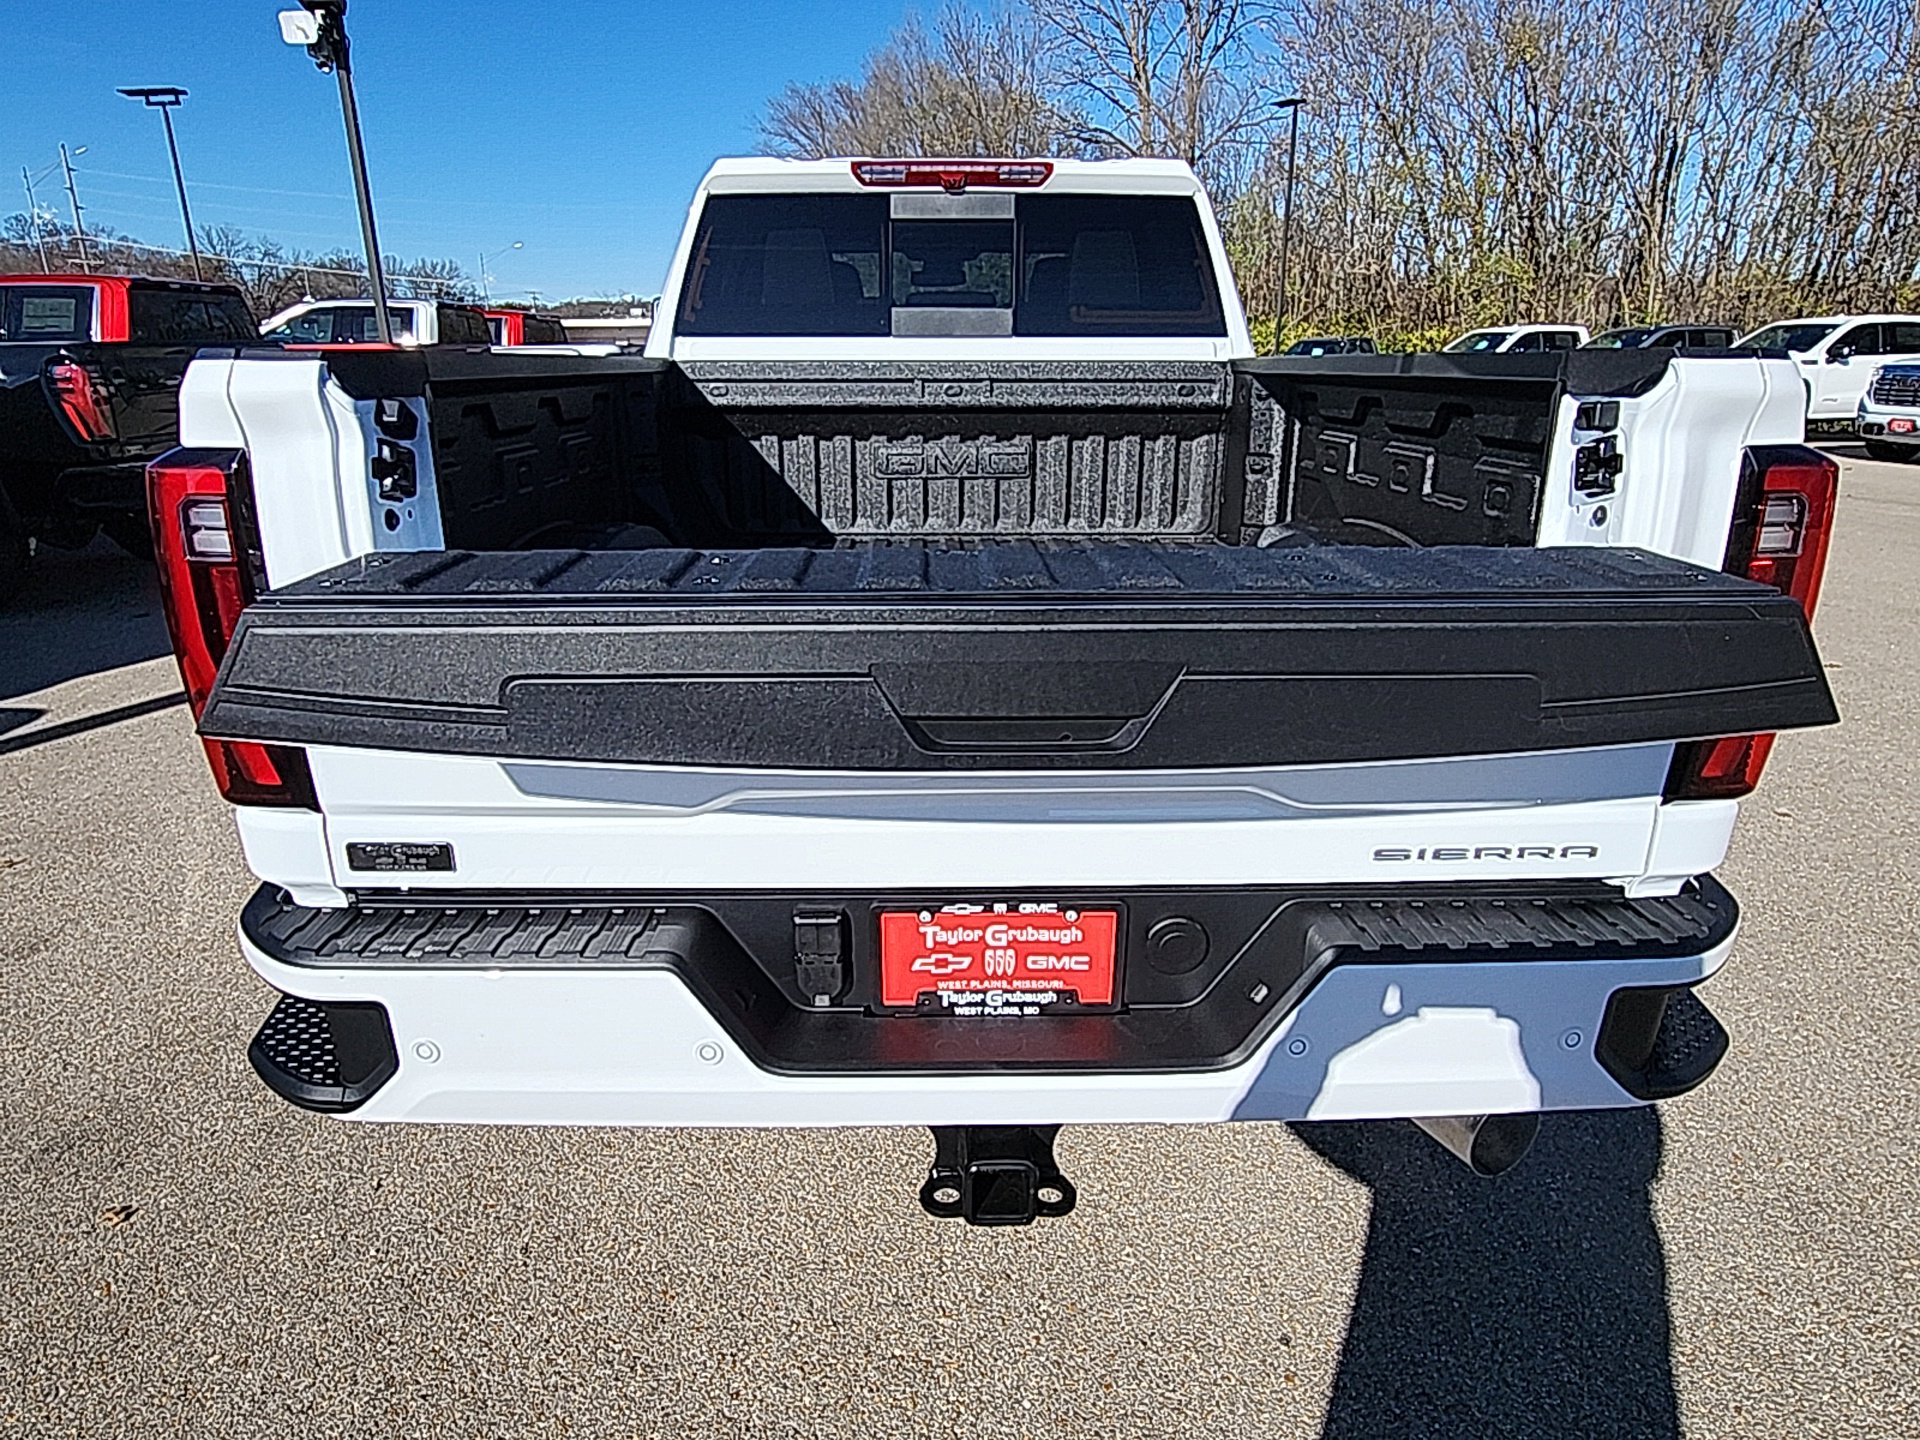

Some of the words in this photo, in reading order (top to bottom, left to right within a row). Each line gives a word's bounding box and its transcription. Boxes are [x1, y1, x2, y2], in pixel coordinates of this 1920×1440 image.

[878, 445, 1030, 477] GMC
[1373, 846, 1598, 861] SIERRA
[1019, 903, 1058, 913] GMC
[918, 926, 983, 948] Taylor
[985, 924, 1083, 946] Grubaugh
[1026, 955, 1091, 970] GMC
[937, 980, 968, 989] WEST
[1013, 980, 1064, 989] MISSOURI
[937, 990, 984, 1007] Taylor
[985, 990, 1057, 1006] Grubaugh
[954, 1006, 982, 1015] WEST
[1023, 1006, 1040, 1015] MO
